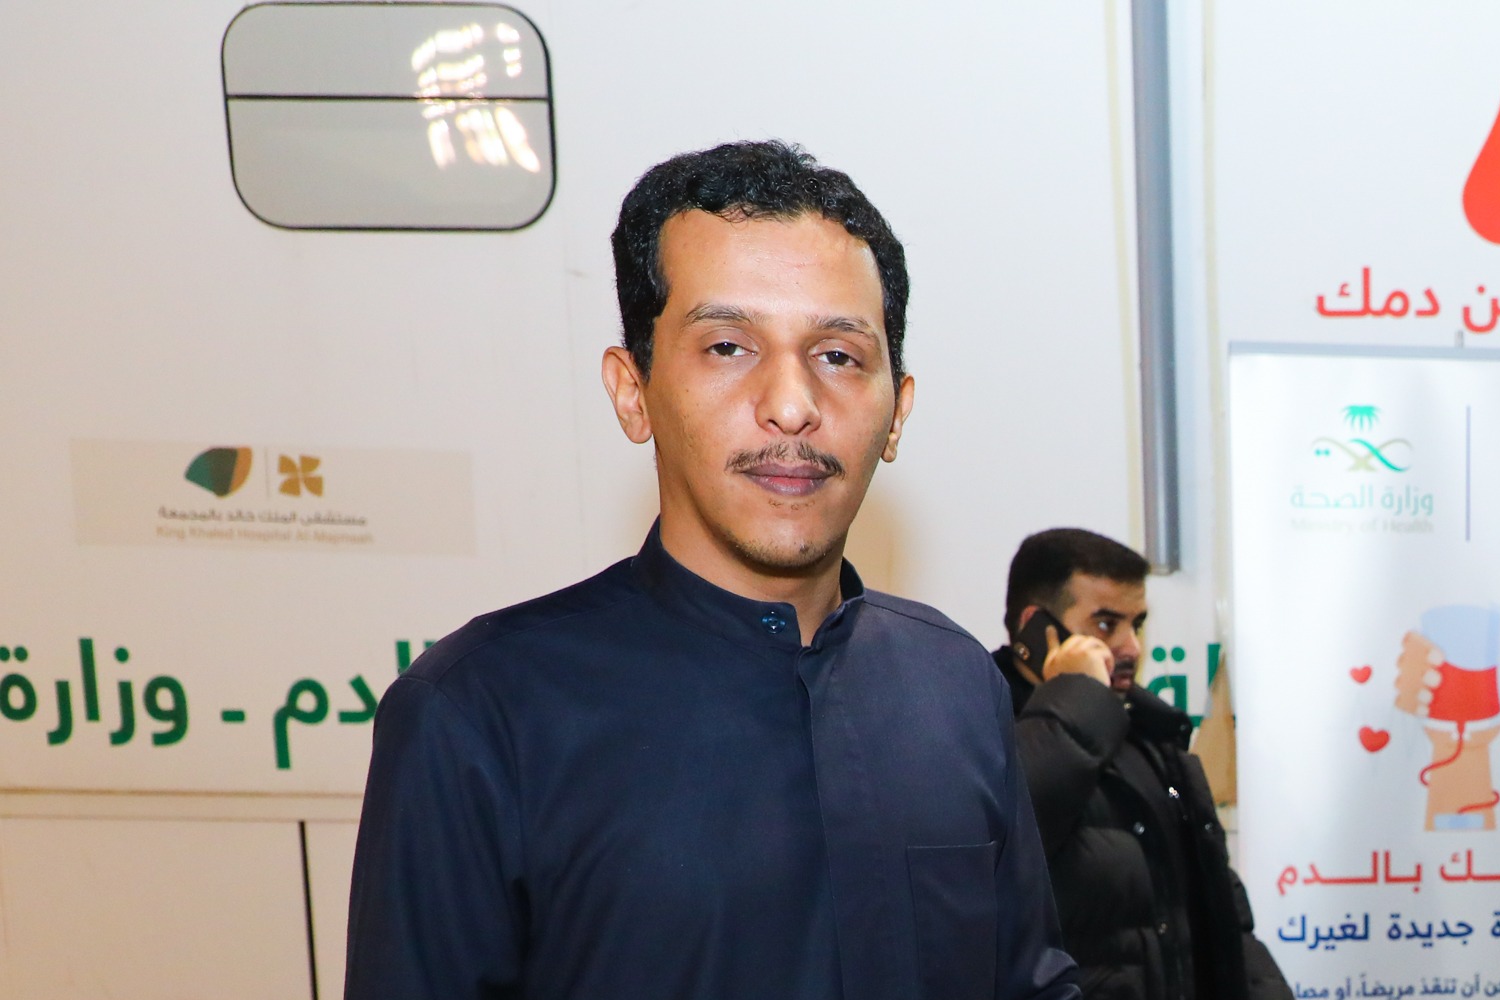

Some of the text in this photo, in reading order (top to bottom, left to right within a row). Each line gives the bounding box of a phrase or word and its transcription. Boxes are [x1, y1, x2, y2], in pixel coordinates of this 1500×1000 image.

[1315, 266, 1441, 318] دمك
[1289, 484, 1434, 517] وزارة الصحة
[0, 636, 191, 747] وزارة
[1276, 849, 1423, 896] بالدم
[1277, 912, 1370, 951] لغيرك
[1387, 912, 1474, 949] جديدة
[1295, 981, 1329, 1000] مصا
[1419, 976, 1457, 996] تنقذ
[1460, 971, 1481, 999] أن
